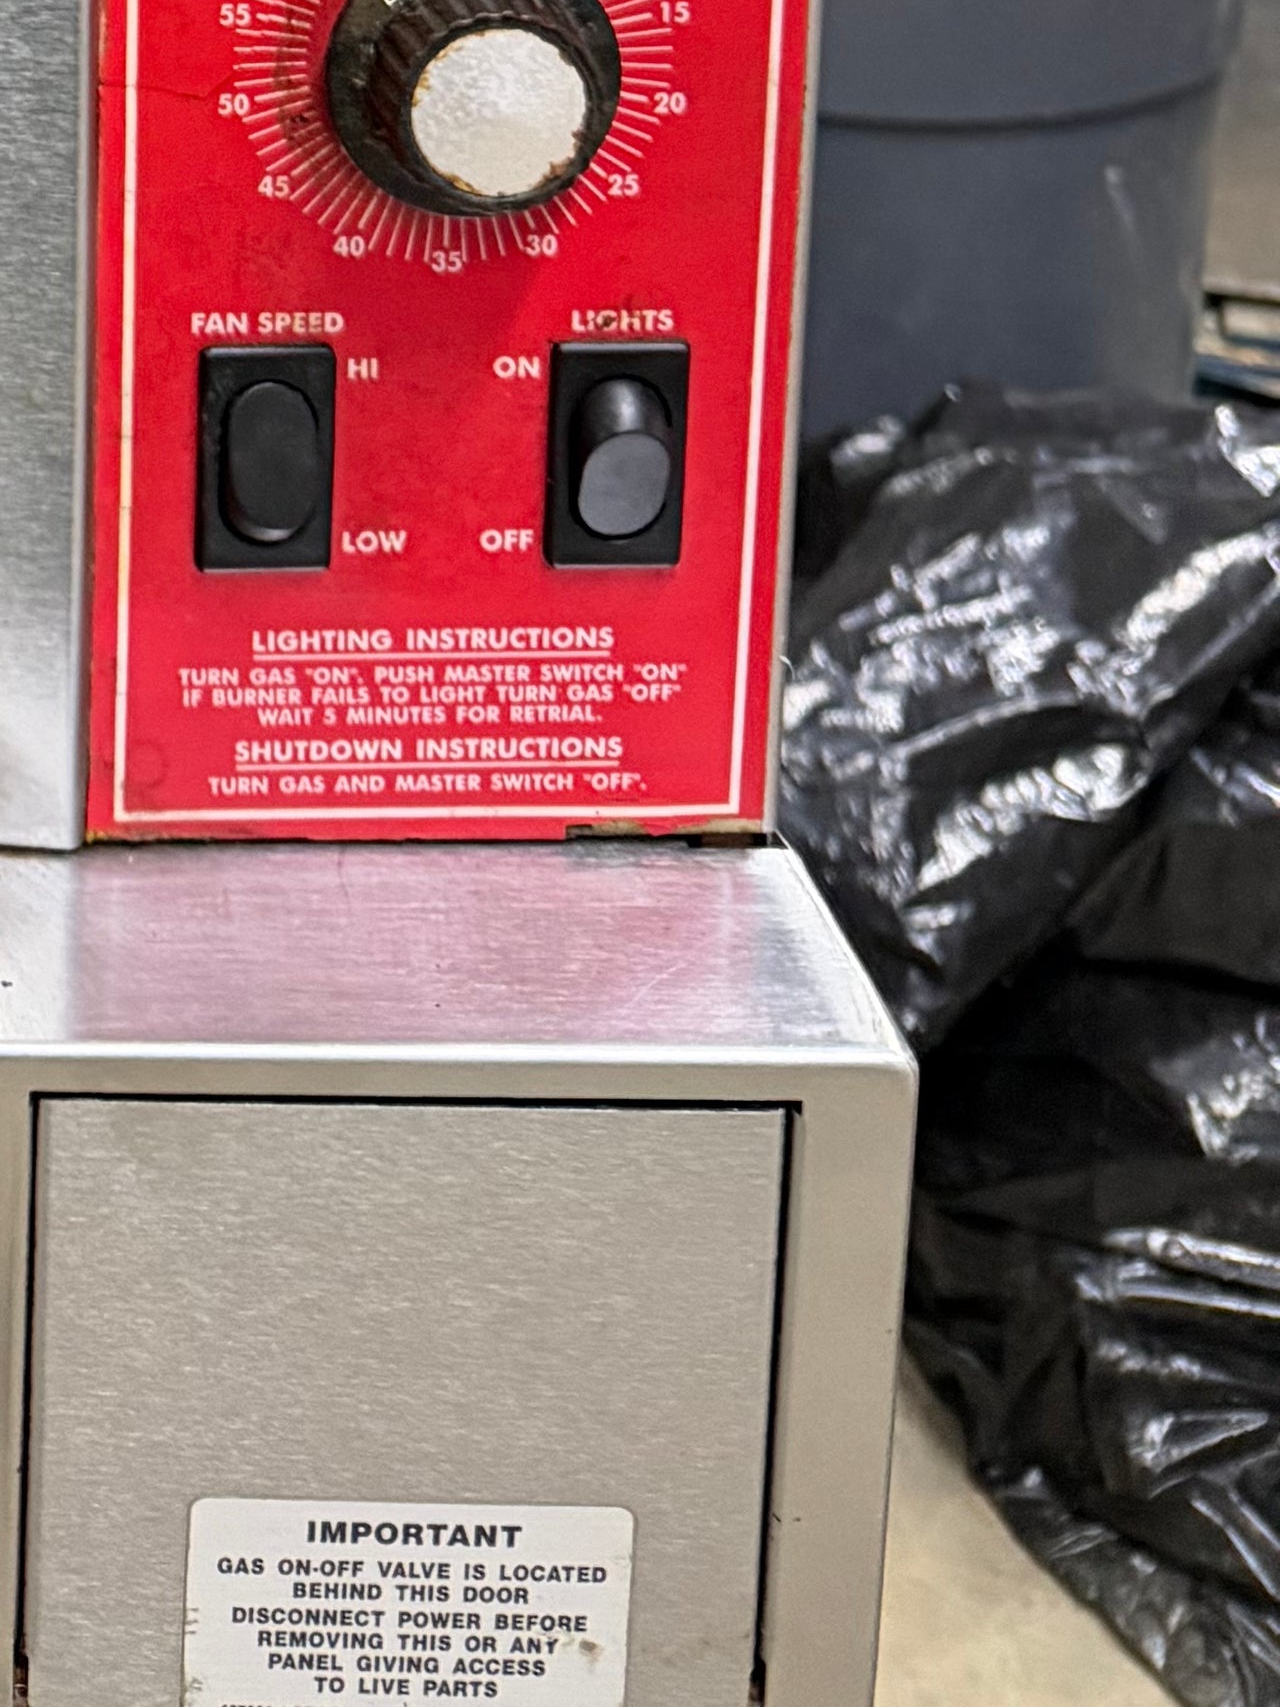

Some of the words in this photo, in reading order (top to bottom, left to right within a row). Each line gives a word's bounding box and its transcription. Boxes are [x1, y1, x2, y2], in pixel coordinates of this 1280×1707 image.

[219, 3, 252, 27] 55
[659, 1, 691, 24] 15
[217, 94, 250, 117] 50
[653, 93, 687, 115] 20
[257, 176, 290, 199] 45
[607, 175, 640, 197] 25
[333, 235, 366, 258] 40
[525, 234, 558, 256] 30
[431, 251, 463, 274] 35
[191, 313, 248, 335] FAN
[257, 311, 344, 334] SPEED
[571, 309, 674, 333] LIGHTS
[346, 358, 379, 380] HI
[493, 357, 540, 379] ON
[342, 531, 407, 553] LOW
[479, 530, 534, 553] OFF
[252, 629, 392, 653] LIGHTING
[406, 626, 614, 651] INSTRUCTIONS
[179, 667, 239, 686] TURN
[249, 667, 295, 685] GAS
[374, 665, 434, 684] PUSH
[444, 664, 530, 683] MASTER
[540, 663, 624, 682] SWITCH
[182, 689, 203, 707] IF
[212, 688, 301, 706] BURNER
[311, 686, 370, 705] FAILS
[379, 686, 410, 704] TO
[419, 685, 487, 703] LIGHT
[496, 684, 557, 703] TURN
[567, 684, 613, 702] GAS
[257, 707, 313, 726] WAIT
[323, 707, 336, 725] 5
[346, 706, 446, 725] MINUTES
[455, 705, 500, 724] FOR
[510, 704, 602, 723] RETRIAL.
[234, 738, 403, 762] SHUTDOWN
[416, 736, 623, 760] INSTRUCTIONS
[208, 776, 269, 795] TURN
[279, 776, 325, 793] GAS
[335, 775, 385, 792] AND
[394, 774, 481, 792] MASTER
[490, 773, 574, 791] SWITCH
[306, 1521, 523, 1549] IMPORTANT
[217, 1558, 264, 1575] GAS
[278, 1559, 364, 1577] ON-OFF
[377, 1562, 451, 1580] VALVE
[464, 1564, 485, 1581] IS
[499, 1565, 607, 1583] LOCATED
[293, 1584, 382, 1601] BEHIND
[395, 1586, 449, 1603] THIS
[463, 1587, 529, 1605] DOOR
[232, 1608, 385, 1627] DISCONNECT
[398, 1612, 481, 1630] POWER
[495, 1614, 588, 1632] BEFORE
[257, 1631, 383, 1650] REMOVING
[398, 1635, 452, 1652] THIS
[465, 1636, 496, 1653] OR
[510, 1637, 558, 1655] ANY
[268, 1654, 343, 1671] PANEL
[356, 1656, 439, 1674] GIVING
[452, 1658, 546, 1677] ACCESS
[315, 1677, 342, 1694] TO
[358, 1678, 409, 1696] LIVE
[423, 1680, 497, 1698] PARTS
